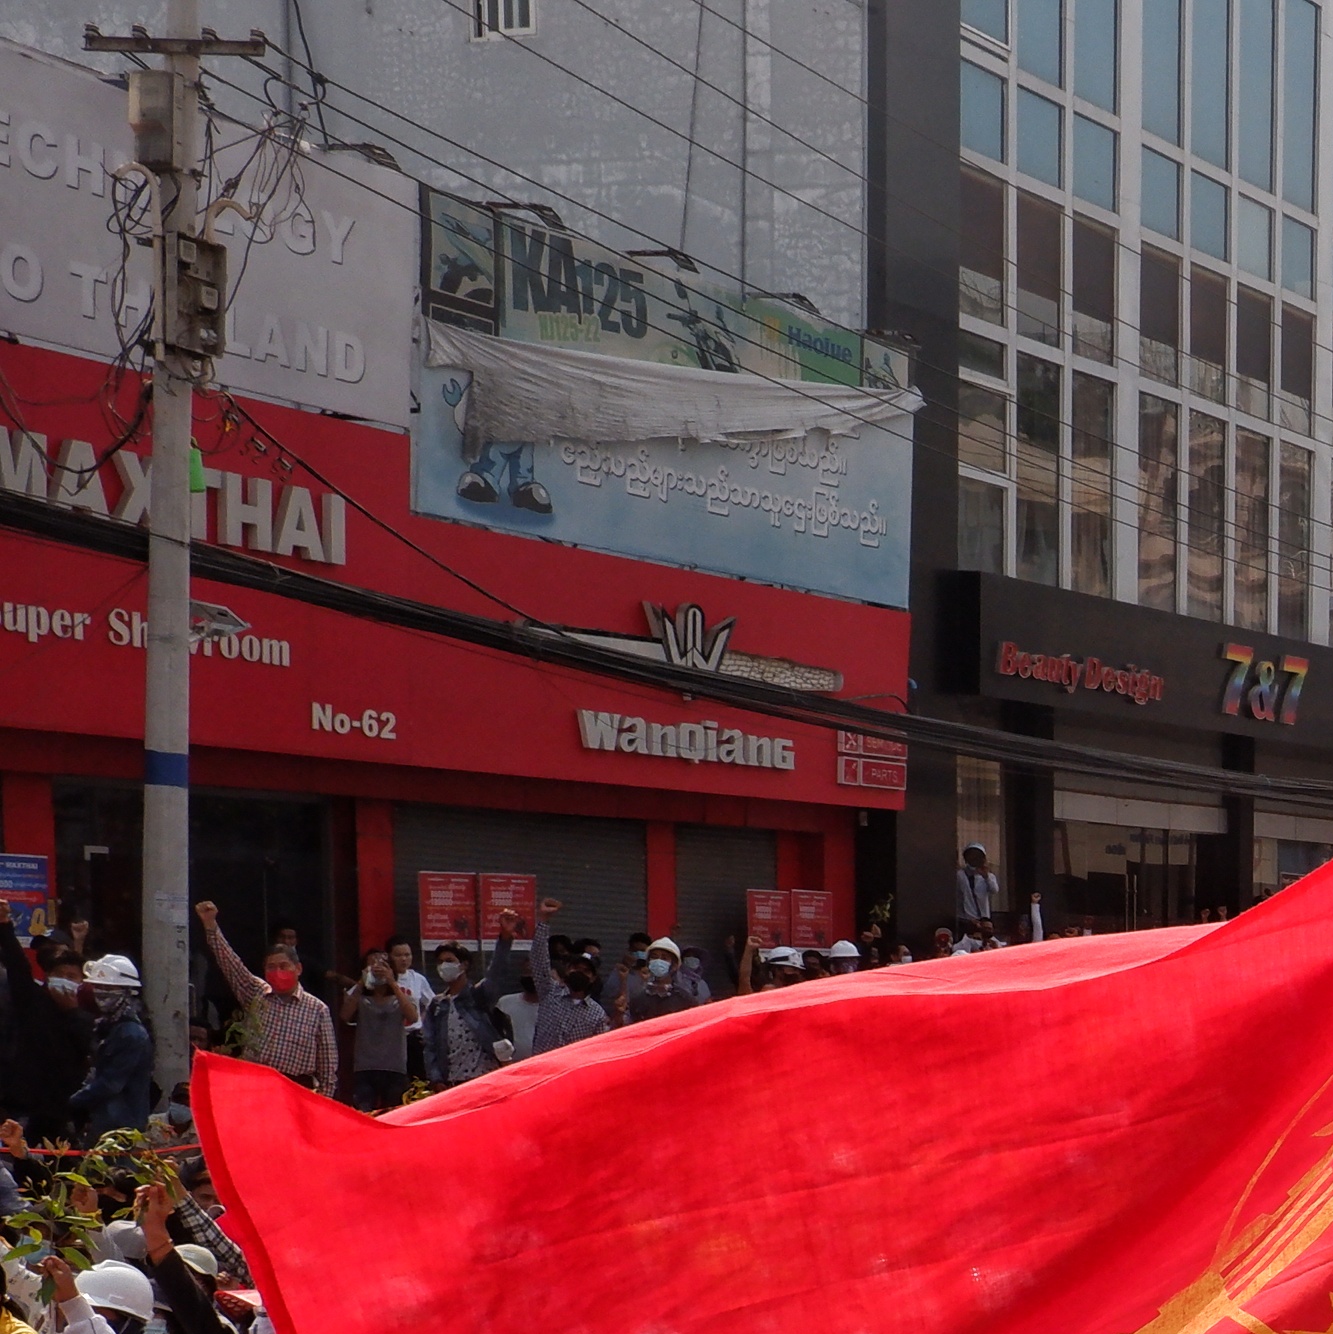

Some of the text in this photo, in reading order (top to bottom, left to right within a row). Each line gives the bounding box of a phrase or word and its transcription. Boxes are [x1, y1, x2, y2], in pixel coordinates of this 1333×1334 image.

[509, 222, 648, 340] KA125
[787, 325, 853, 364] Haojue
[0, 601, 292, 667] uper Shroom
[999, 641, 1164, 706] Beauty Design
[1221, 641, 1310, 726] 7&7
[311, 701, 397, 740] No-62
[871, 768, 898, 783] PARTS
